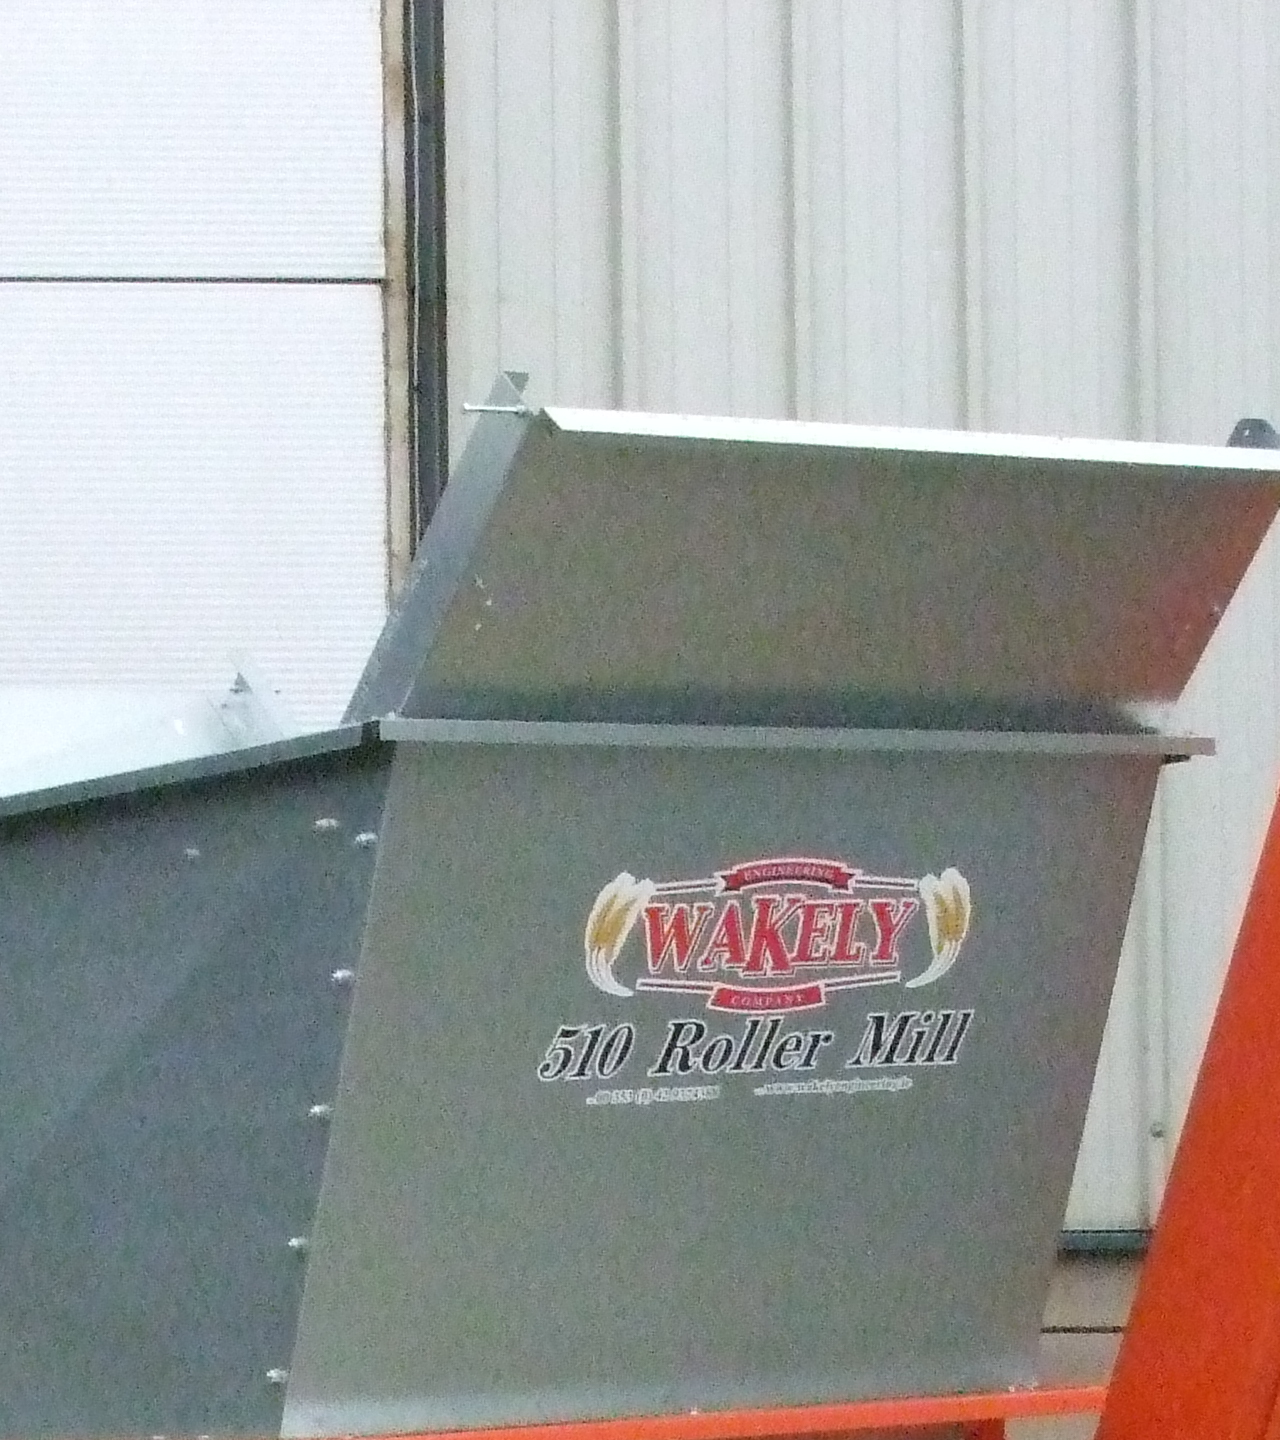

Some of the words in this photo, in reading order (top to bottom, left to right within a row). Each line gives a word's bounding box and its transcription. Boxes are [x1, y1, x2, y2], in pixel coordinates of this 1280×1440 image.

[743, 864, 836, 881] ENGINEERING
[641, 893, 920, 978] WAKELY
[731, 993, 805, 1007] COMPANY
[538, 1022, 635, 1082] 510
[647, 1014, 835, 1078] Roller
[845, 1008, 976, 1069] Mill
